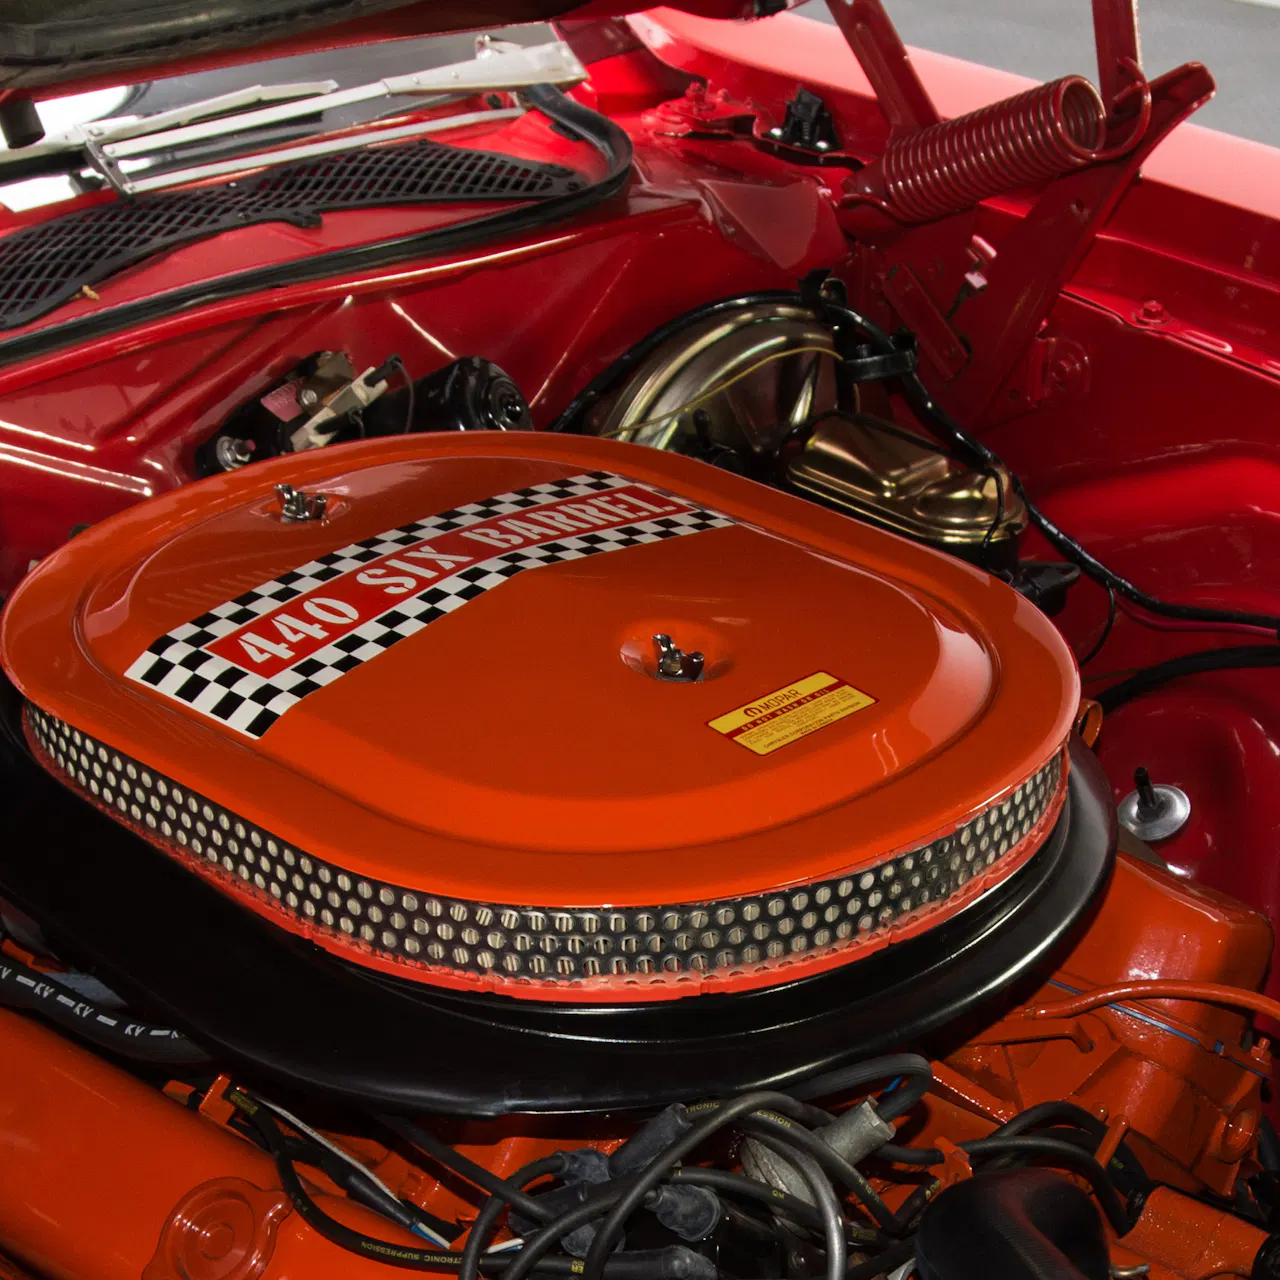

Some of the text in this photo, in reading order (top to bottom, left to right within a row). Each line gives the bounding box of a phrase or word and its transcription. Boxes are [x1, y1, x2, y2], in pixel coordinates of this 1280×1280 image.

[236, 492, 678, 664] 440 SIX BARREL
[757, 714, 774, 725] NOT
[775, 702, 799, 716] WASH
[814, 688, 831, 698] OIL
[760, 689, 803, 712] MOPAR
[34, 982, 55, 998] KV
[73, 1002, 95, 1018] KV
[124, 1023, 146, 1037] KV
[685, 1101, 719, 1114] TRONIC
[424, 1255, 462, 1265] TRONIC
